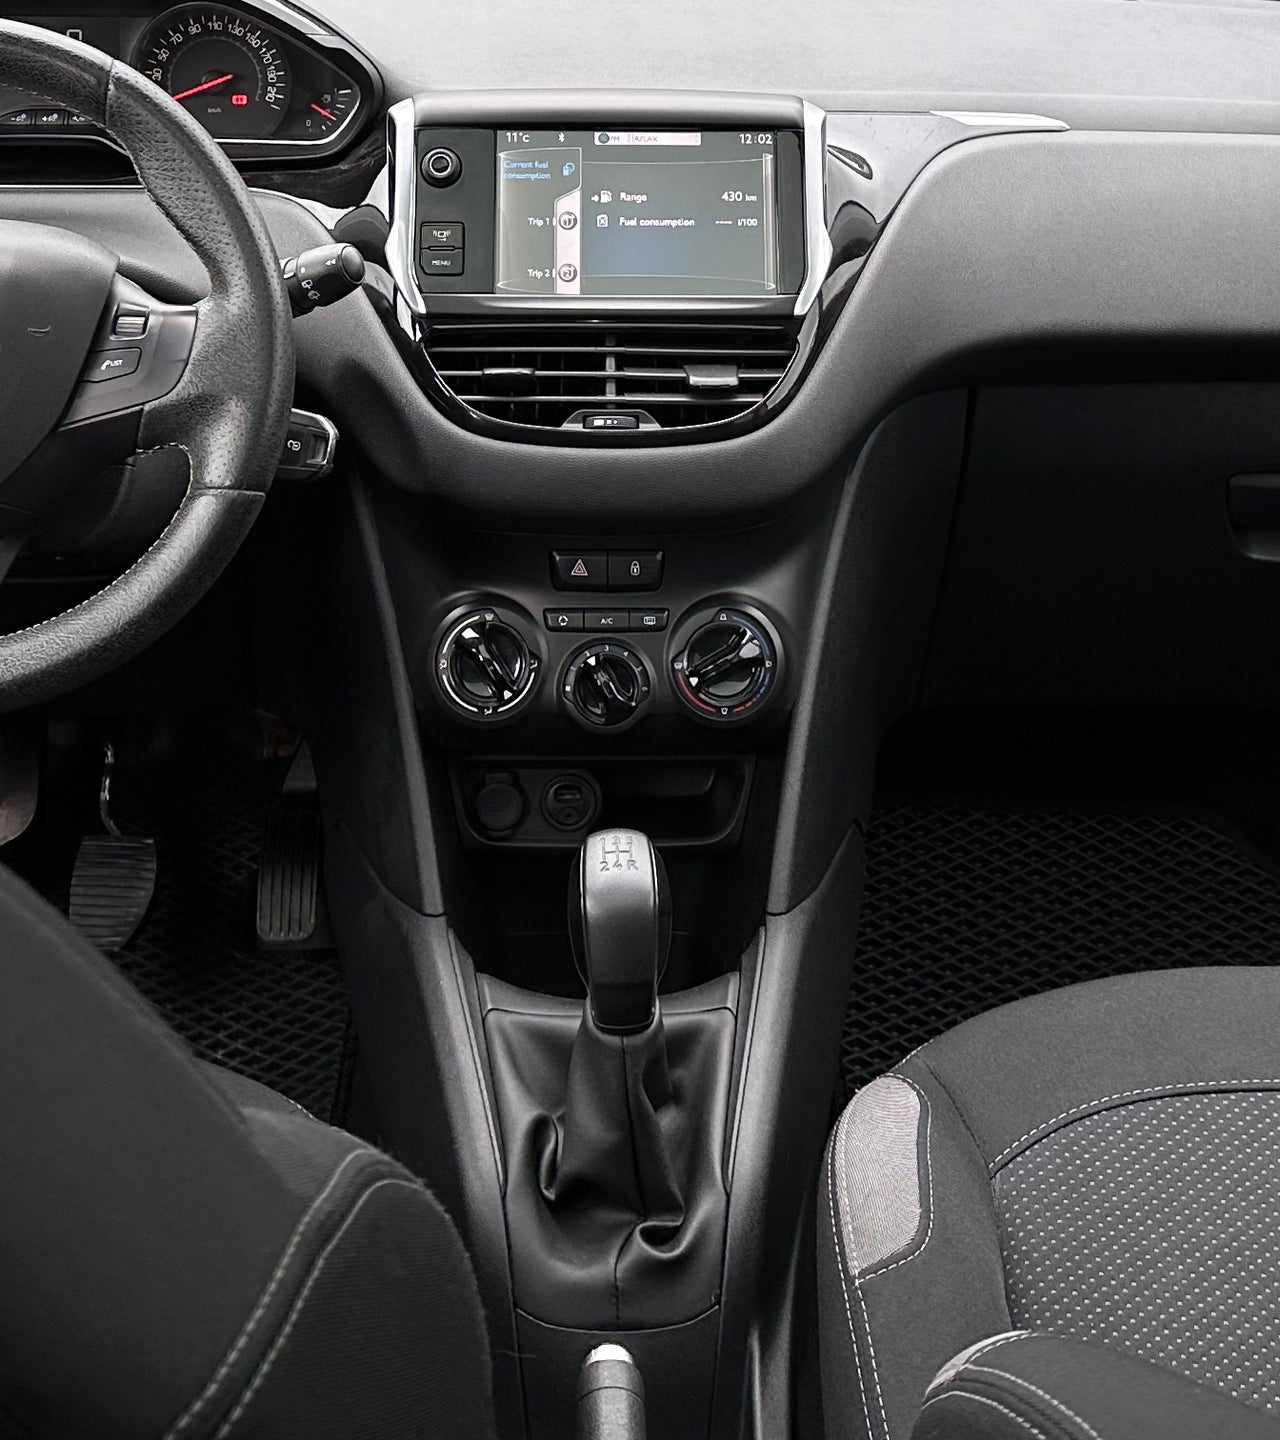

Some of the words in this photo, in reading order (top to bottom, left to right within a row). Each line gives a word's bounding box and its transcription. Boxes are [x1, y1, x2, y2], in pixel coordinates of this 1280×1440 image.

[187, 23, 202, 35] 90
[207, 21, 223, 31] 110
[227, 22, 245, 36] 130
[169, 33, 183, 46] 70
[245, 33, 261, 48] 150
[157, 48, 170, 62] 50
[259, 47, 272, 64] 170
[152, 68, 163, 81] 30
[265, 86, 277, 103] 210
[738, 133, 773, 145] 12:02
[619, 192, 648, 203] Range
[721, 191, 743, 202] 430
[527, 217, 544, 227] Trip
[619, 217, 637, 227] Fuel
[639, 217, 695, 229] consumption
[527, 269, 544, 279] Trip
[544, 269, 551, 278] 2
[600, 617, 614, 625] A/C
[600, 860, 610, 871] 2
[627, 859, 639, 871] R
